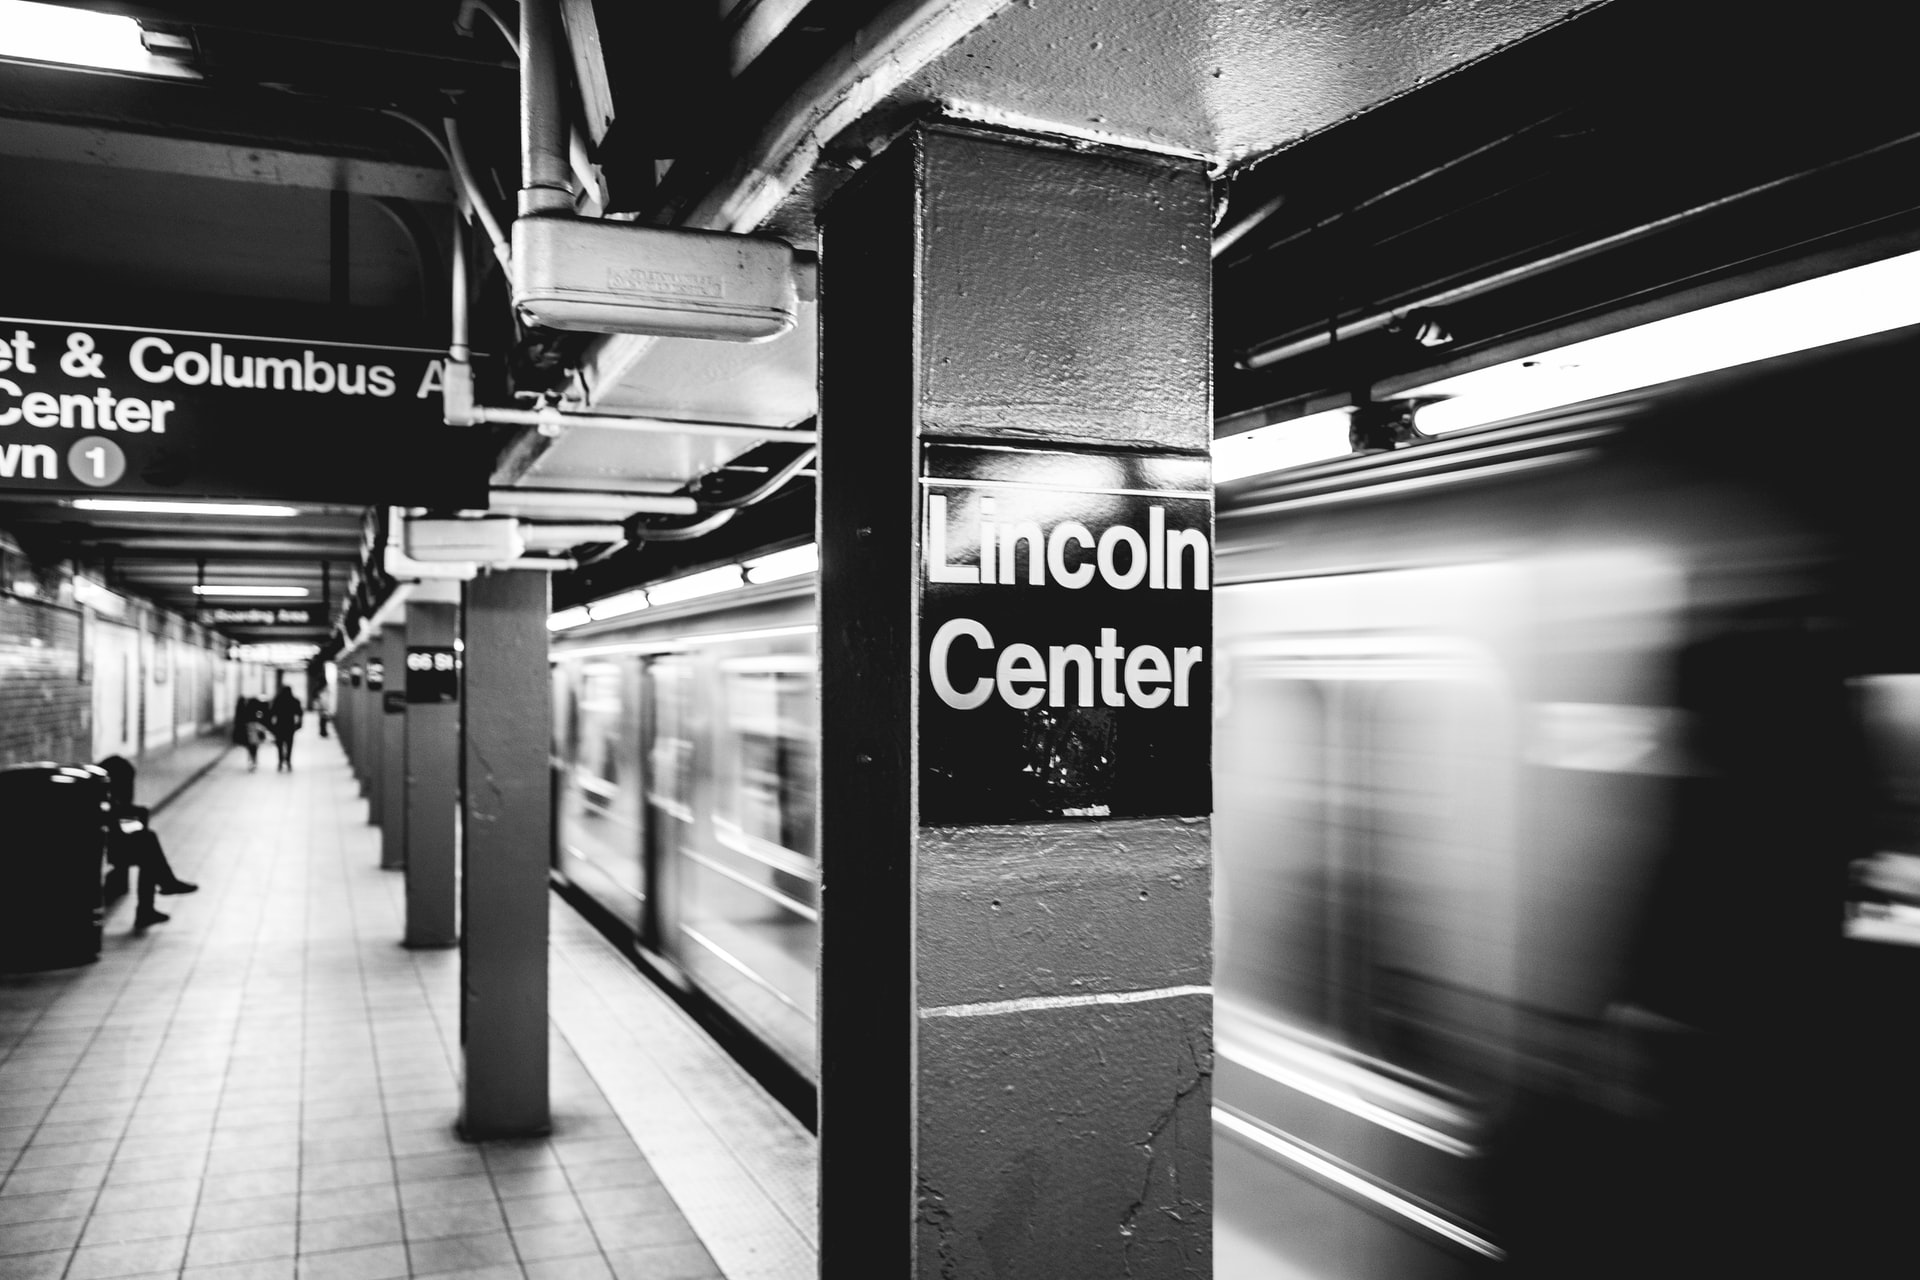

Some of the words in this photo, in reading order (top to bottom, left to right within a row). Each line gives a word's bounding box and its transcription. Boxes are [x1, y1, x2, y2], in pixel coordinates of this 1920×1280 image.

[59, 332, 106, 378] &
[128, 336, 397, 397] Columbus
[85, 446, 106, 479] 1
[928, 494, 1210, 591] Lincoln
[928, 617, 1203, 710] Center
